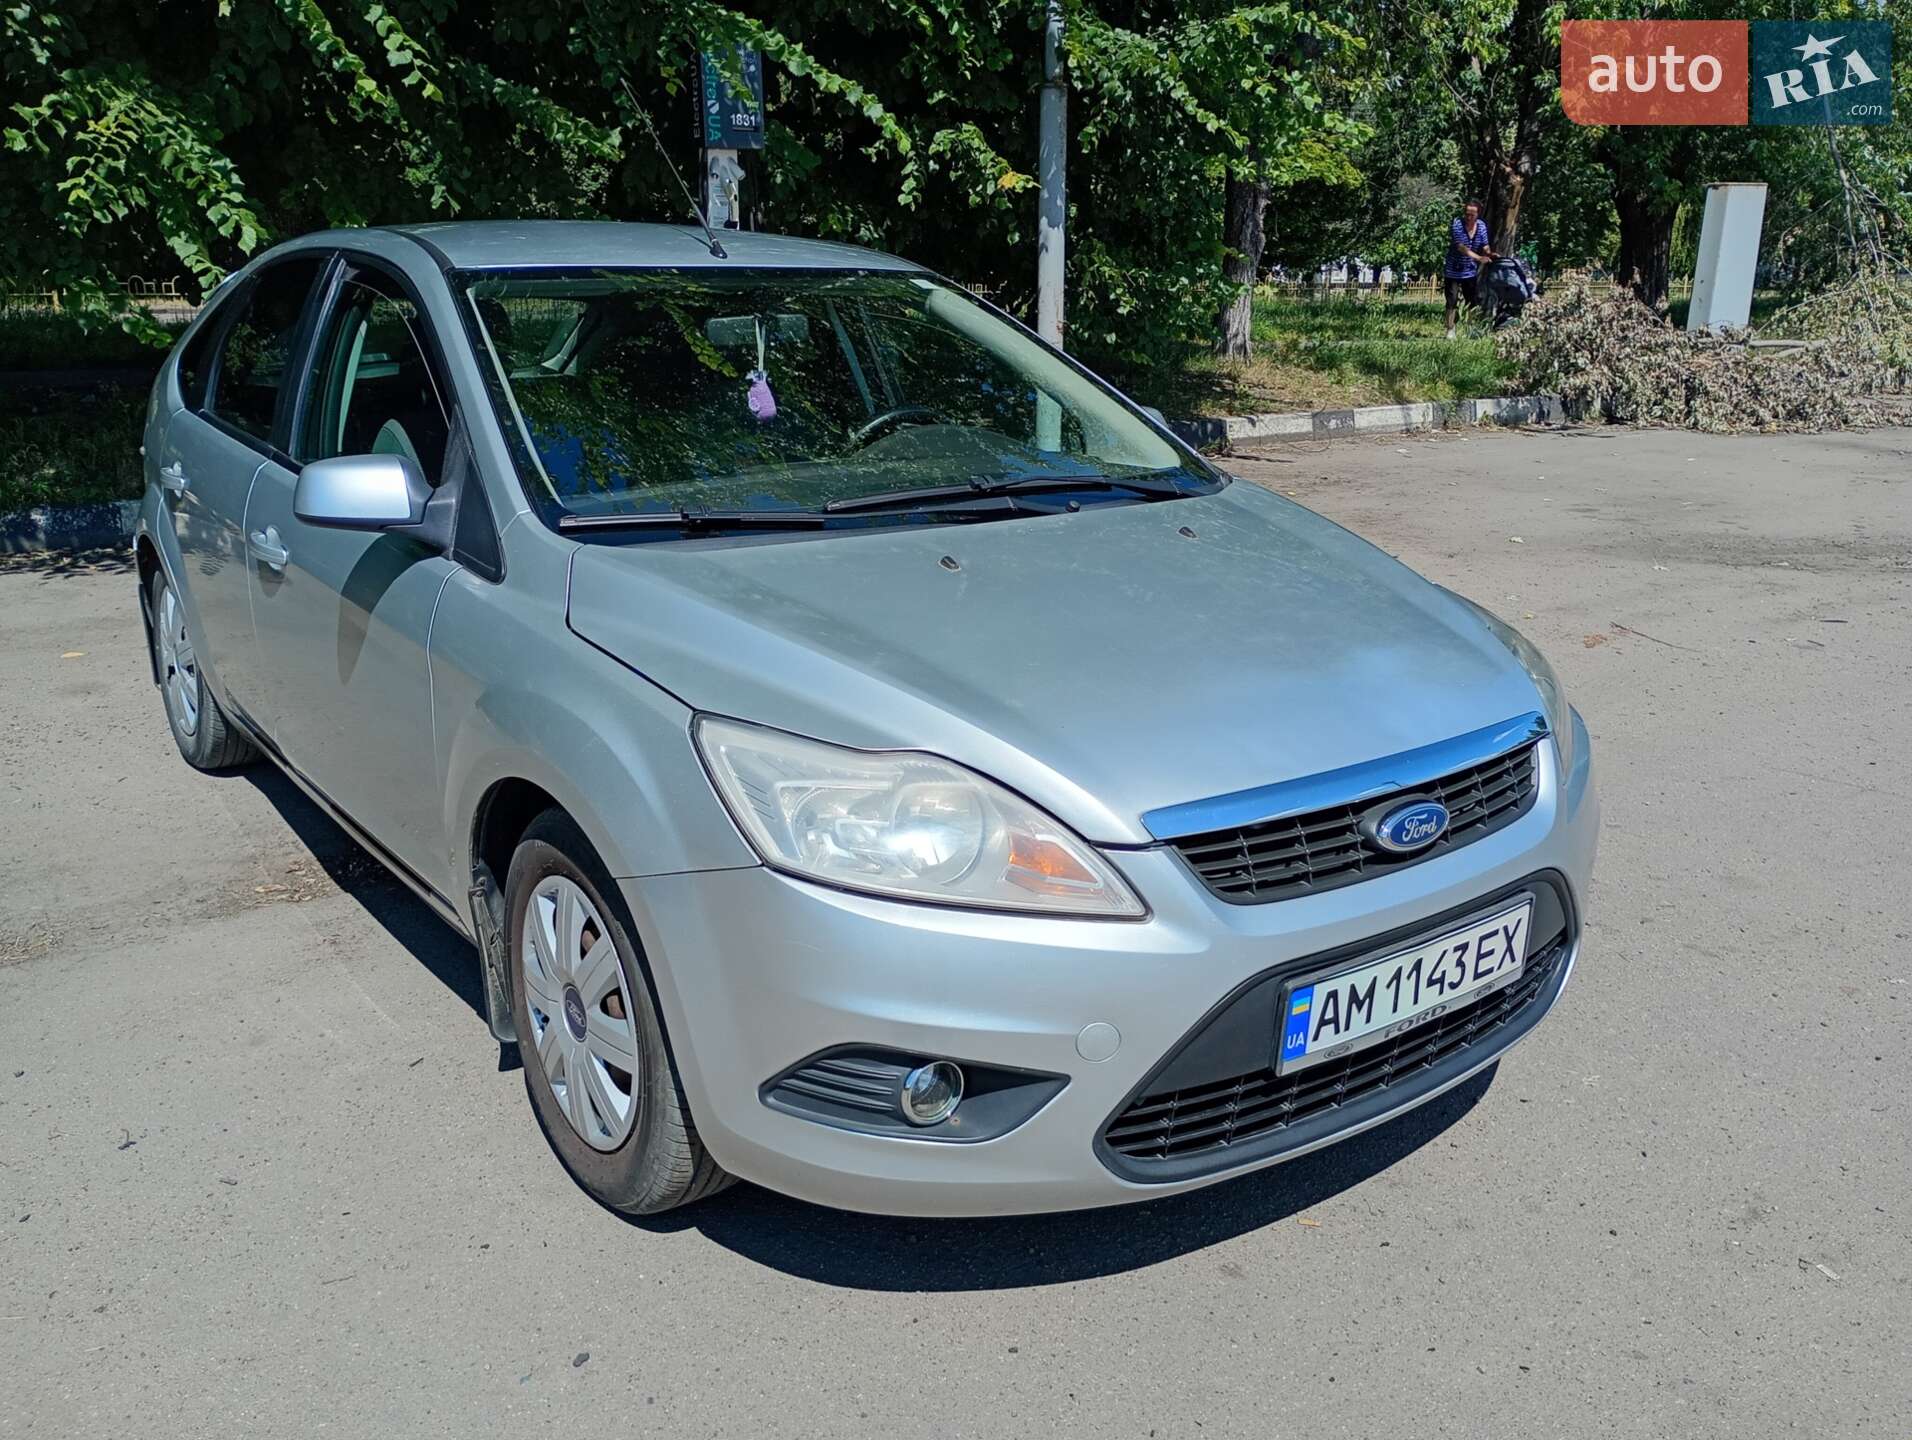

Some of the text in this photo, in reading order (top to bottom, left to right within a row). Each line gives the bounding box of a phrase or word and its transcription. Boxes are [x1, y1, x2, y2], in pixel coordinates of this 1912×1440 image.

[730, 113, 756, 127] 1831
[1402, 813, 1438, 842] Ford
[1312, 918, 1522, 1042] AM 1143 EX
[1384, 1005, 1448, 1039] FORD
[1287, 1032, 1305, 1050] UA
